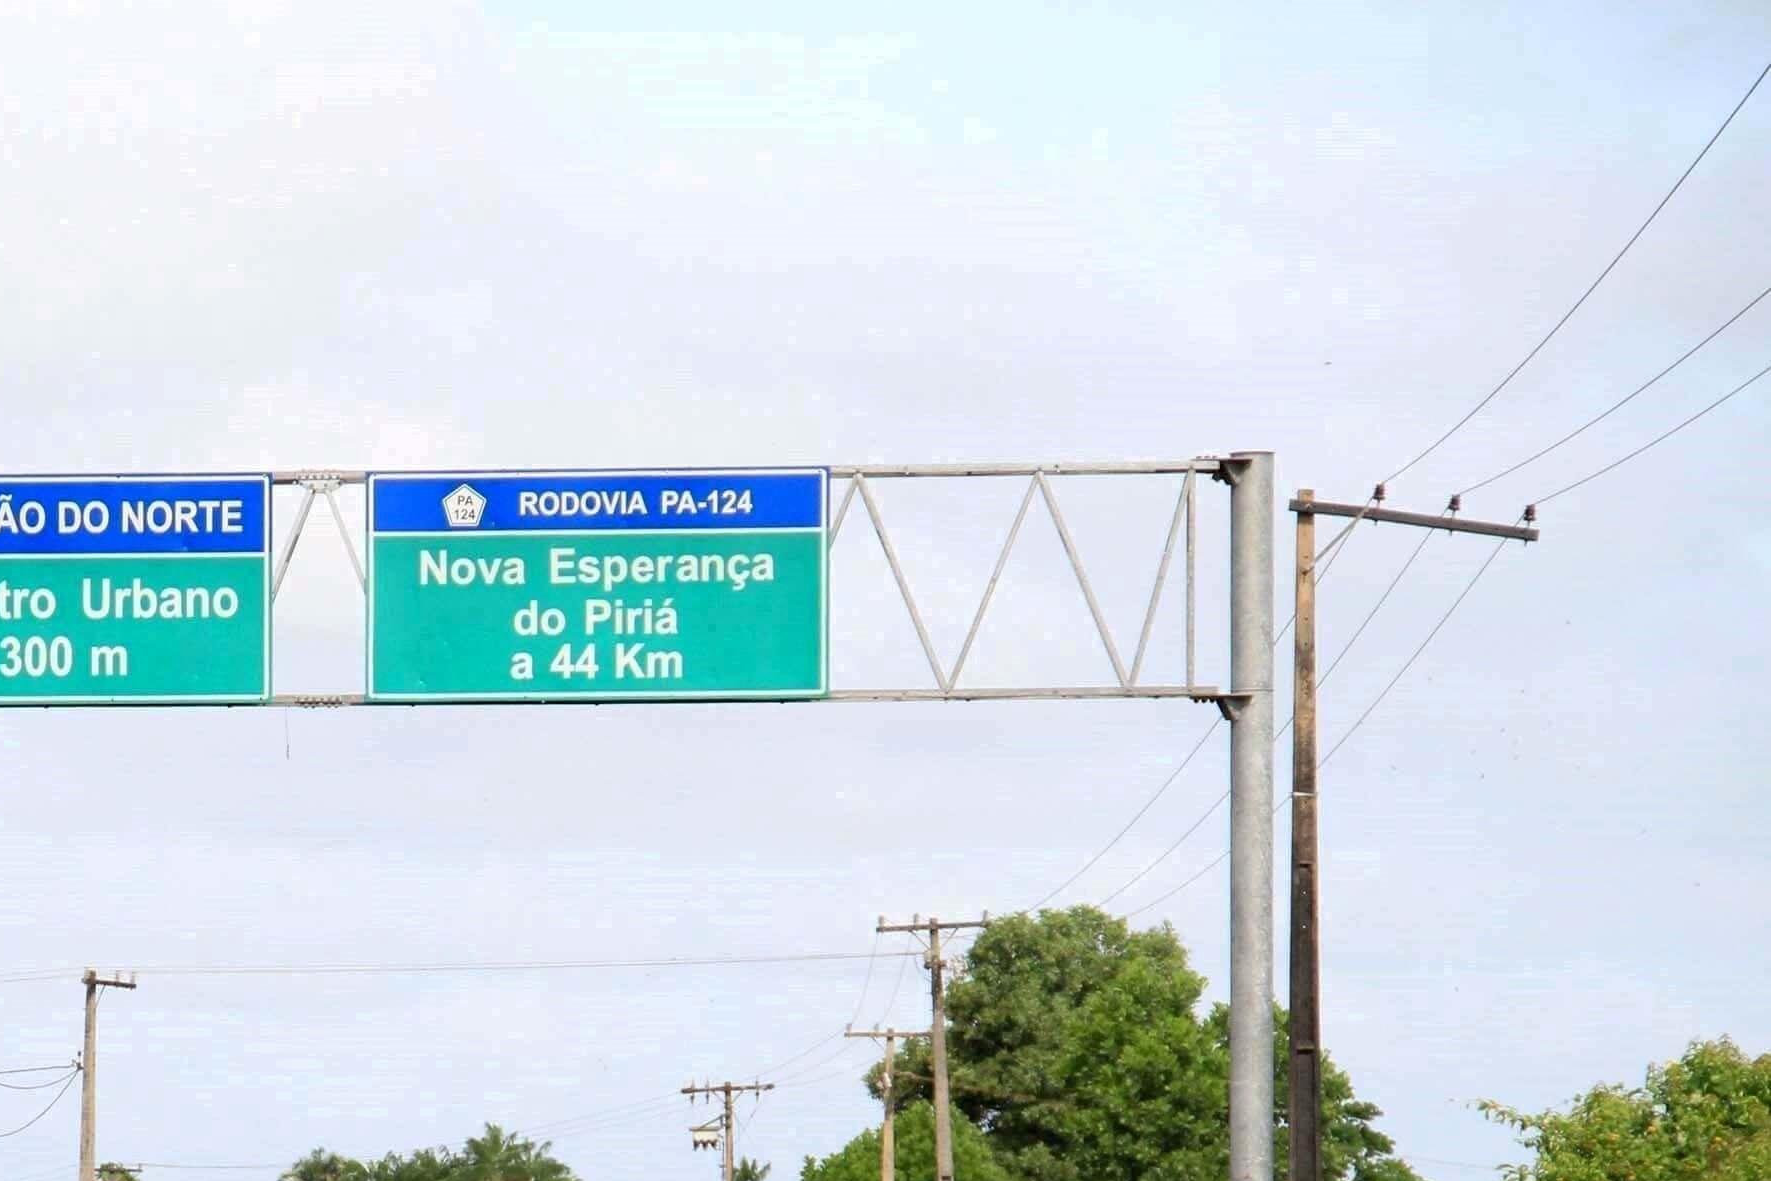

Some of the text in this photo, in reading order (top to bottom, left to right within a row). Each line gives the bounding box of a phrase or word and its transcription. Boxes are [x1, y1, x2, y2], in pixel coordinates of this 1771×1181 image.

[57, 500, 110, 534] DO
[120, 499, 243, 534] NORTE
[454, 508, 476, 520] 124
[457, 495, 473, 506] PA
[518, 490, 753, 516] RODOVIA PA-124
[418, 548, 774, 592] Nova Esperança
[81, 577, 239, 620] Urbano
[512, 598, 678, 637] do Piriá
[90, 645, 128, 677] m
[509, 642, 684, 681] a 44 Km
